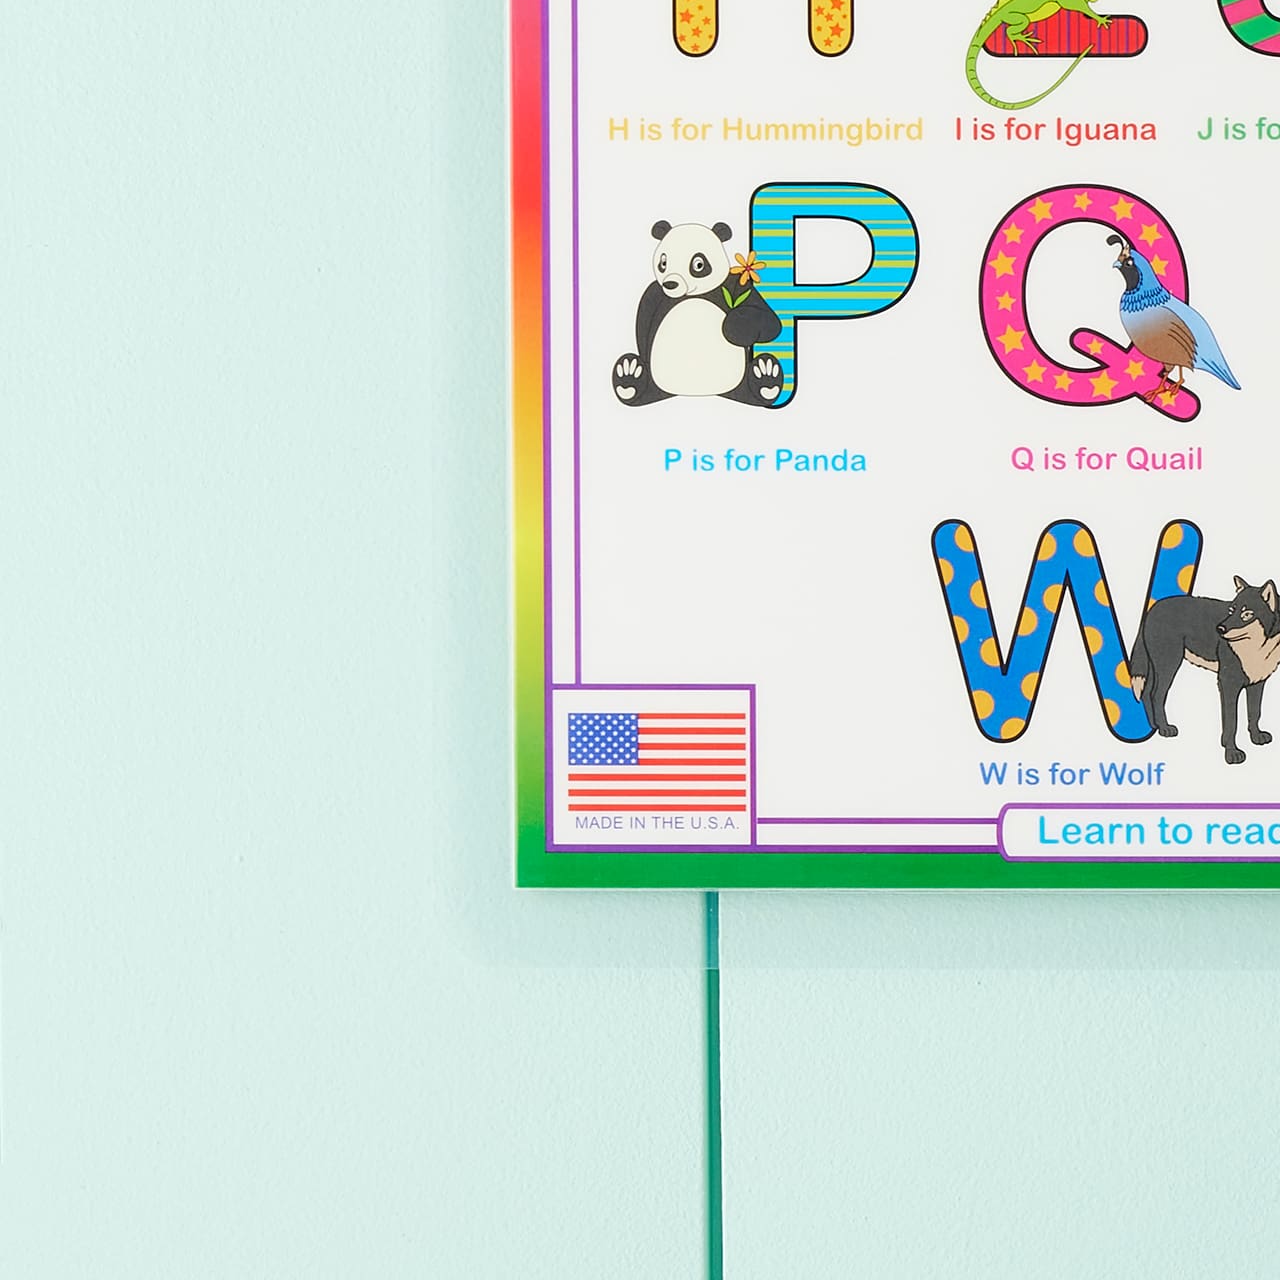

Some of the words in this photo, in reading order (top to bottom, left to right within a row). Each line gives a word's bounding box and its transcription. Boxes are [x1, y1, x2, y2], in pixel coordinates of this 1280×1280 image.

[609, 118, 628, 140] H
[640, 119, 662, 140] is
[672, 118, 712, 140] for
[723, 118, 922, 147] Hummingbird
[576, 816, 623, 829] MADE
[630, 817, 645, 829] IN
[652, 816, 684, 829] THE
[691, 817, 739, 829] U.S.A.
[1039, 816, 1145, 845] Learn
[1157, 816, 1193, 845] to
